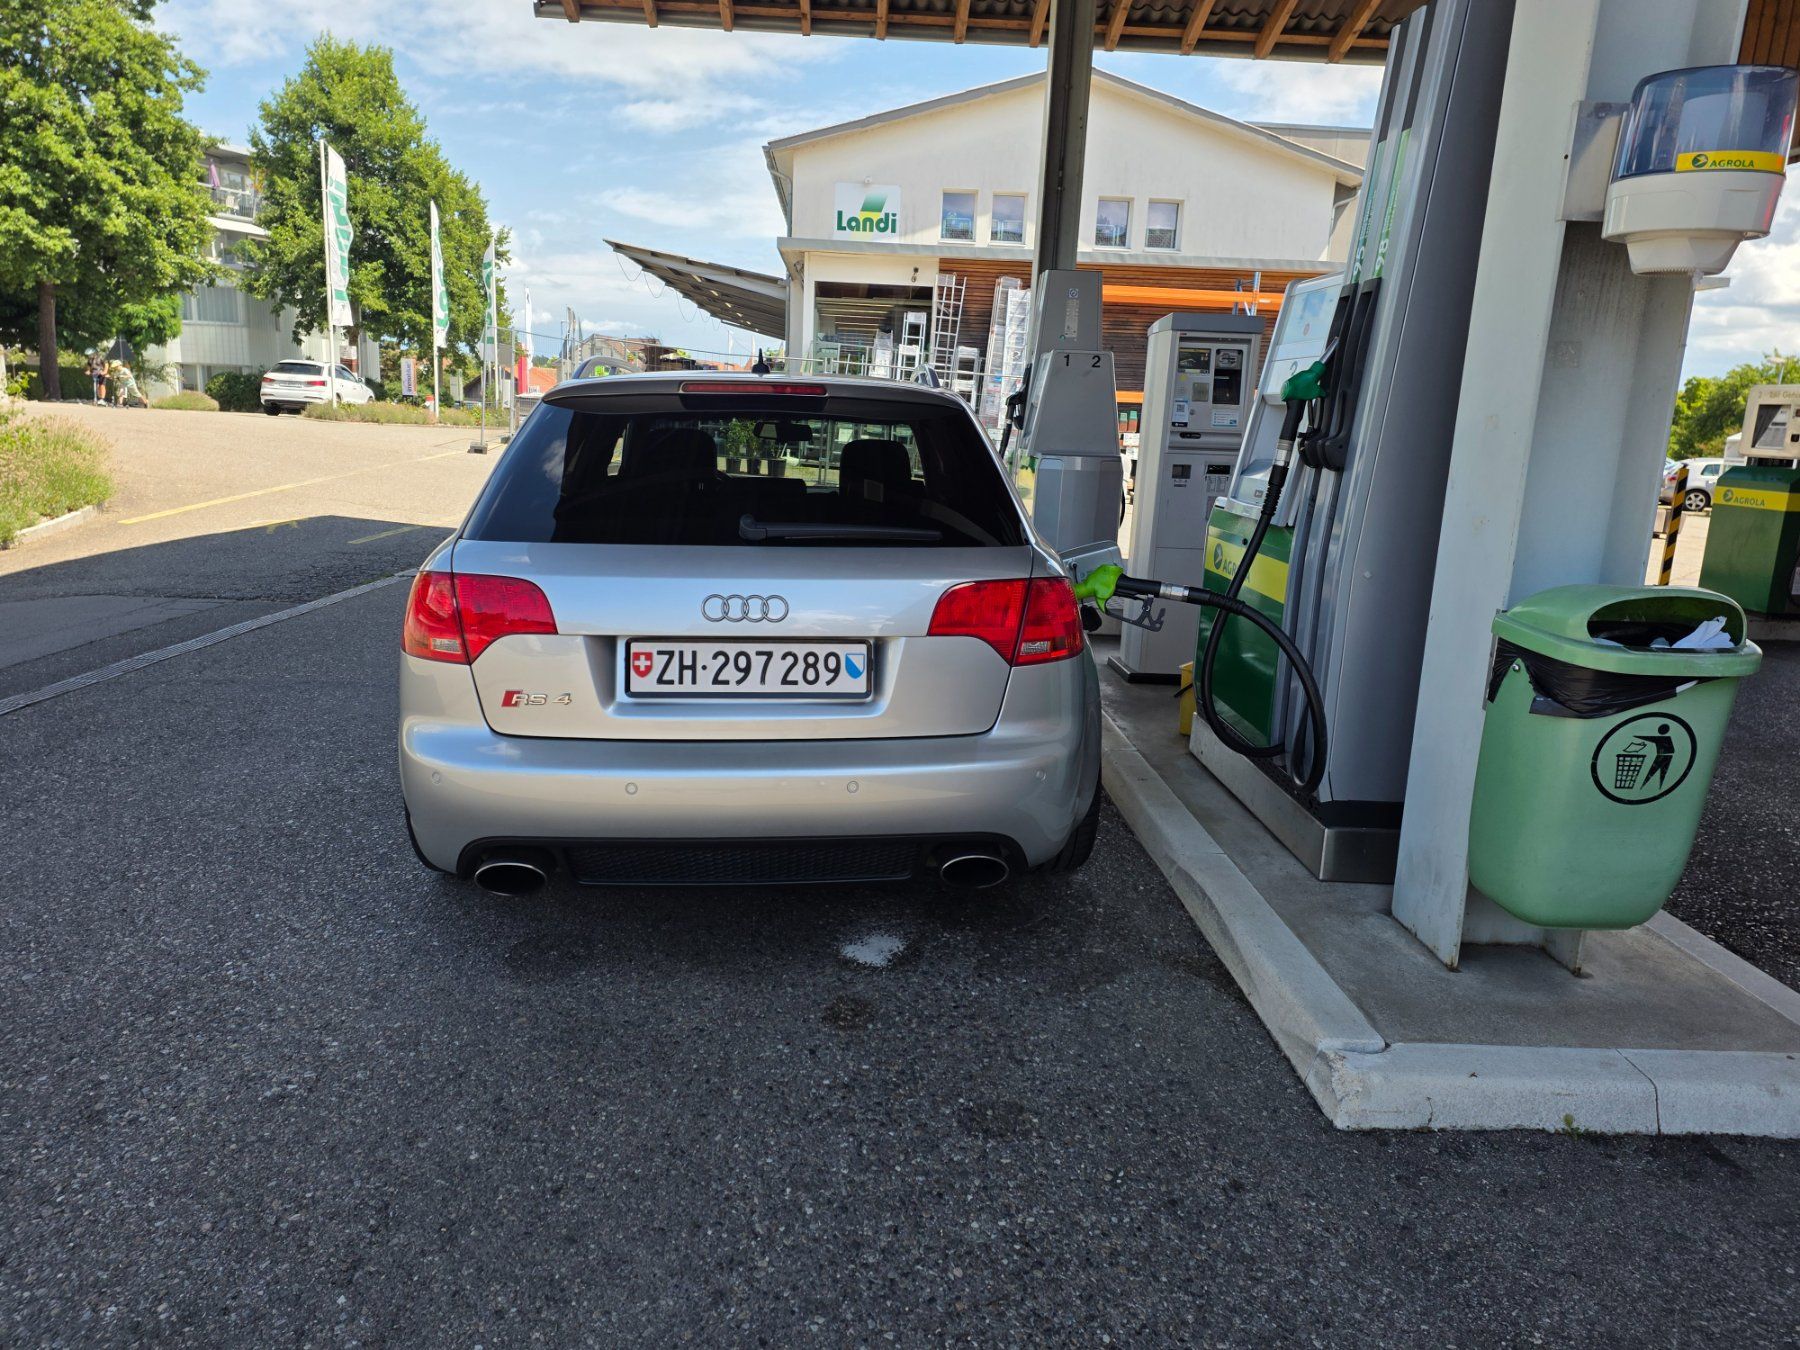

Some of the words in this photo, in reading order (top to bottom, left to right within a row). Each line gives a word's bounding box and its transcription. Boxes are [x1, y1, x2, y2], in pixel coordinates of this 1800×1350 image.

[1709, 159, 1755, 169] AGROLA
[836, 210, 897, 234] Landi
[1063, 353, 1070, 367] 1
[1091, 355, 1102, 368] 2
[1733, 496, 1766, 507] AGROLA
[510, 693, 548, 706] RS
[551, 692, 573, 706] 4
